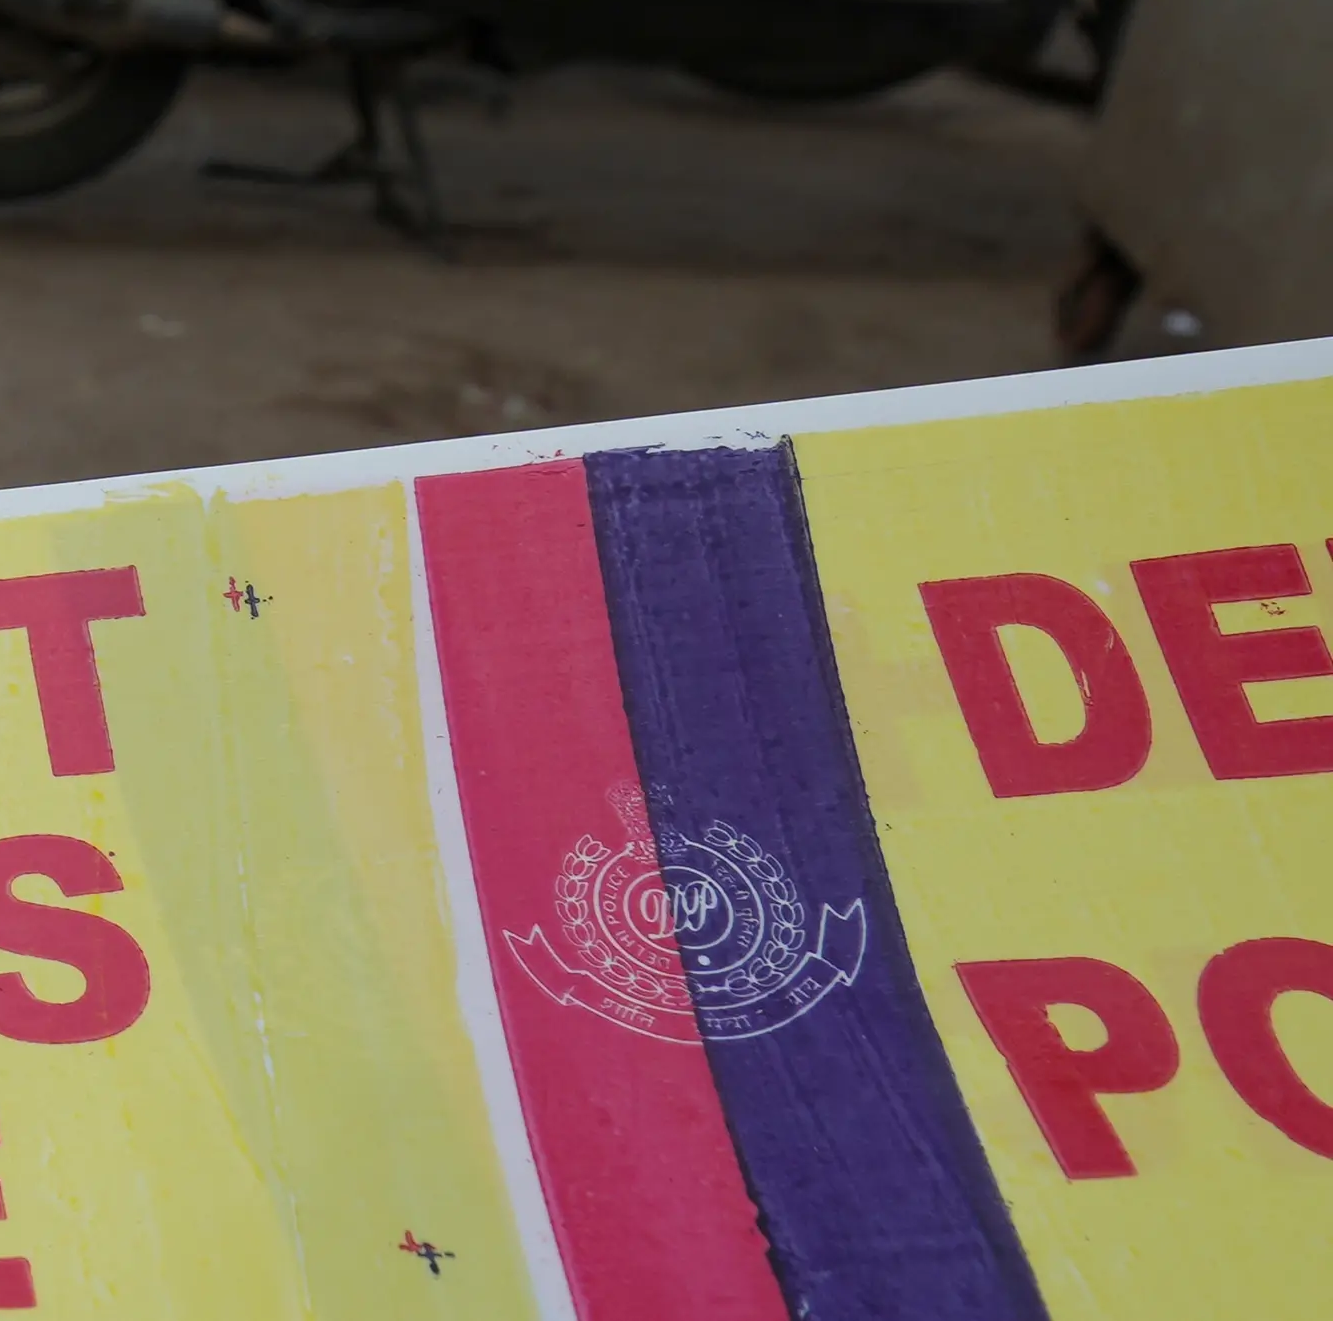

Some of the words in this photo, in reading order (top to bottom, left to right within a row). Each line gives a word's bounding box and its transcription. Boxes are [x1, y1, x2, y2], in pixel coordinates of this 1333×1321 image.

[918, 537, 1333, 798] DE
[603, 866, 630, 925] POLICE
[615, 929, 671, 969] DELHI
